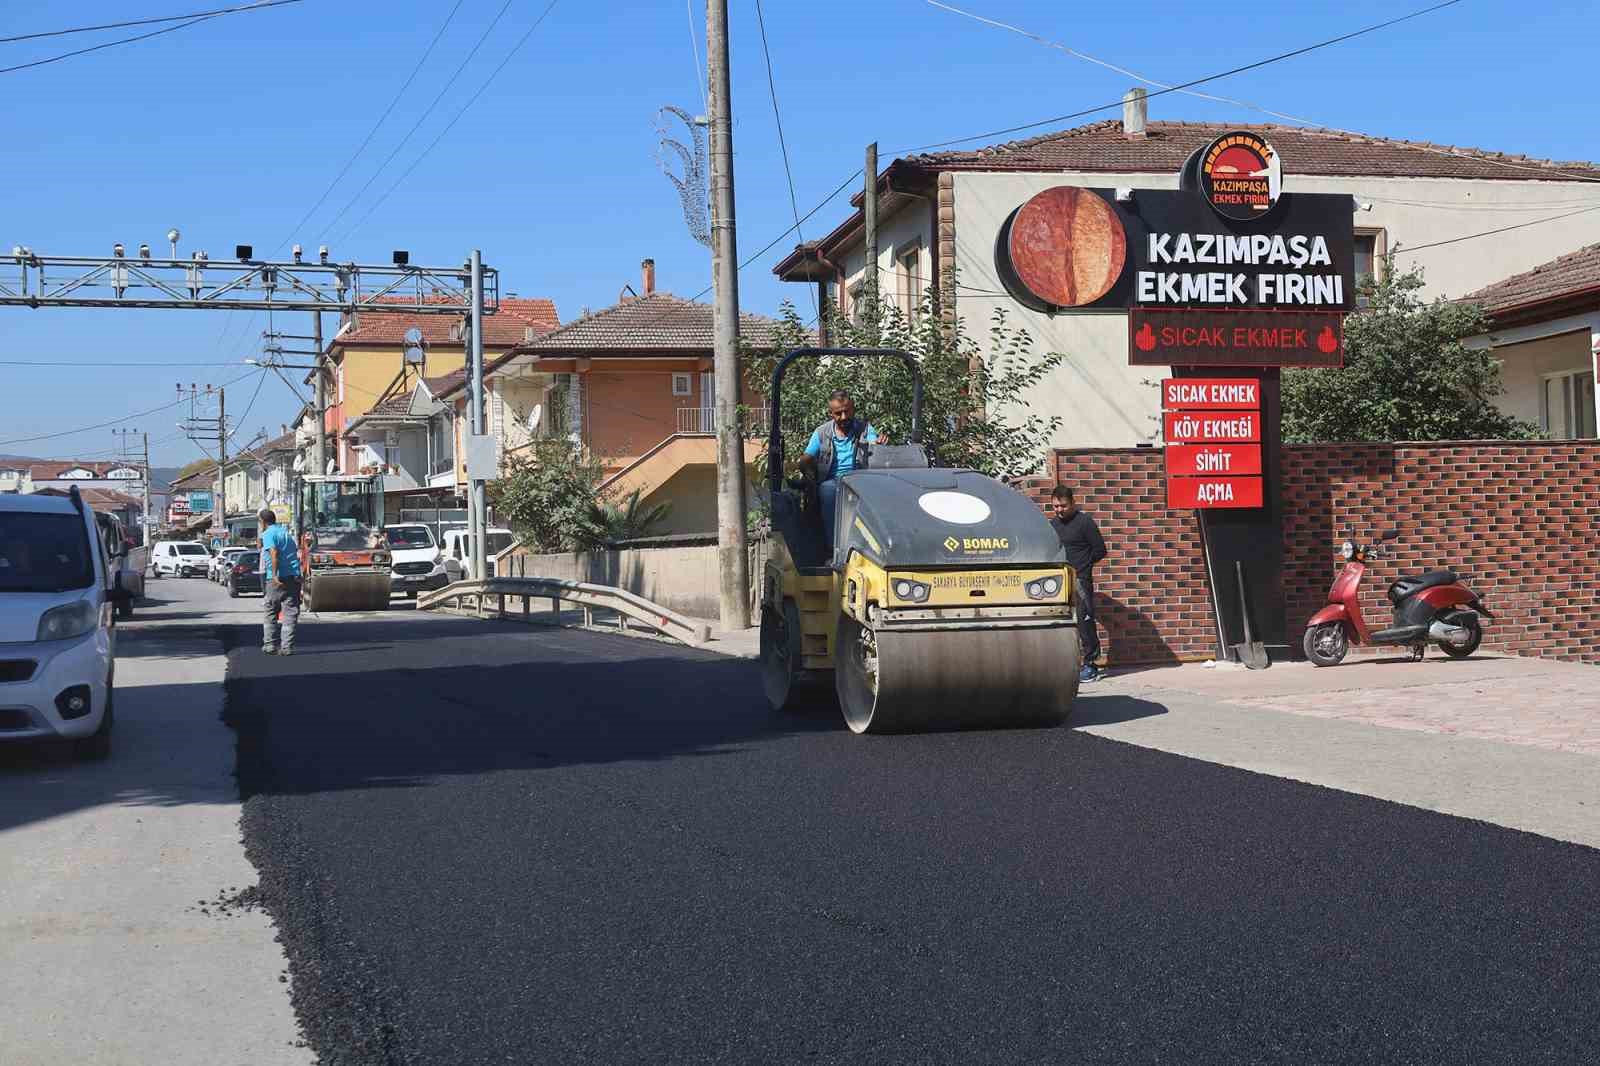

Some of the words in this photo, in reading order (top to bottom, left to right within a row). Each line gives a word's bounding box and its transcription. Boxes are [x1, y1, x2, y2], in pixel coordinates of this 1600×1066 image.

[1213, 181, 1268, 194] KAZIMPAŞA
[1214, 194, 1242, 204] EKMEK
[1244, 194, 1268, 205] FIRINI
[1149, 233, 1331, 268] KAZIMPAŞA
[1137, 271, 1248, 303] EKMEK
[1258, 274, 1344, 304] FIRINI
[1160, 327, 1225, 347] SICAK
[1233, 327, 1309, 348] EKMEK
[1168, 385, 1207, 402] SICAK
[1211, 385, 1256, 402] EKMEK
[1174, 416, 1200, 437] KÖY
[1203, 416, 1252, 437] EKMEĞİ
[1196, 449, 1232, 471] SİMİT
[1197, 483, 1234, 504] AÇMA
[963, 538, 1008, 549] BOMAG
